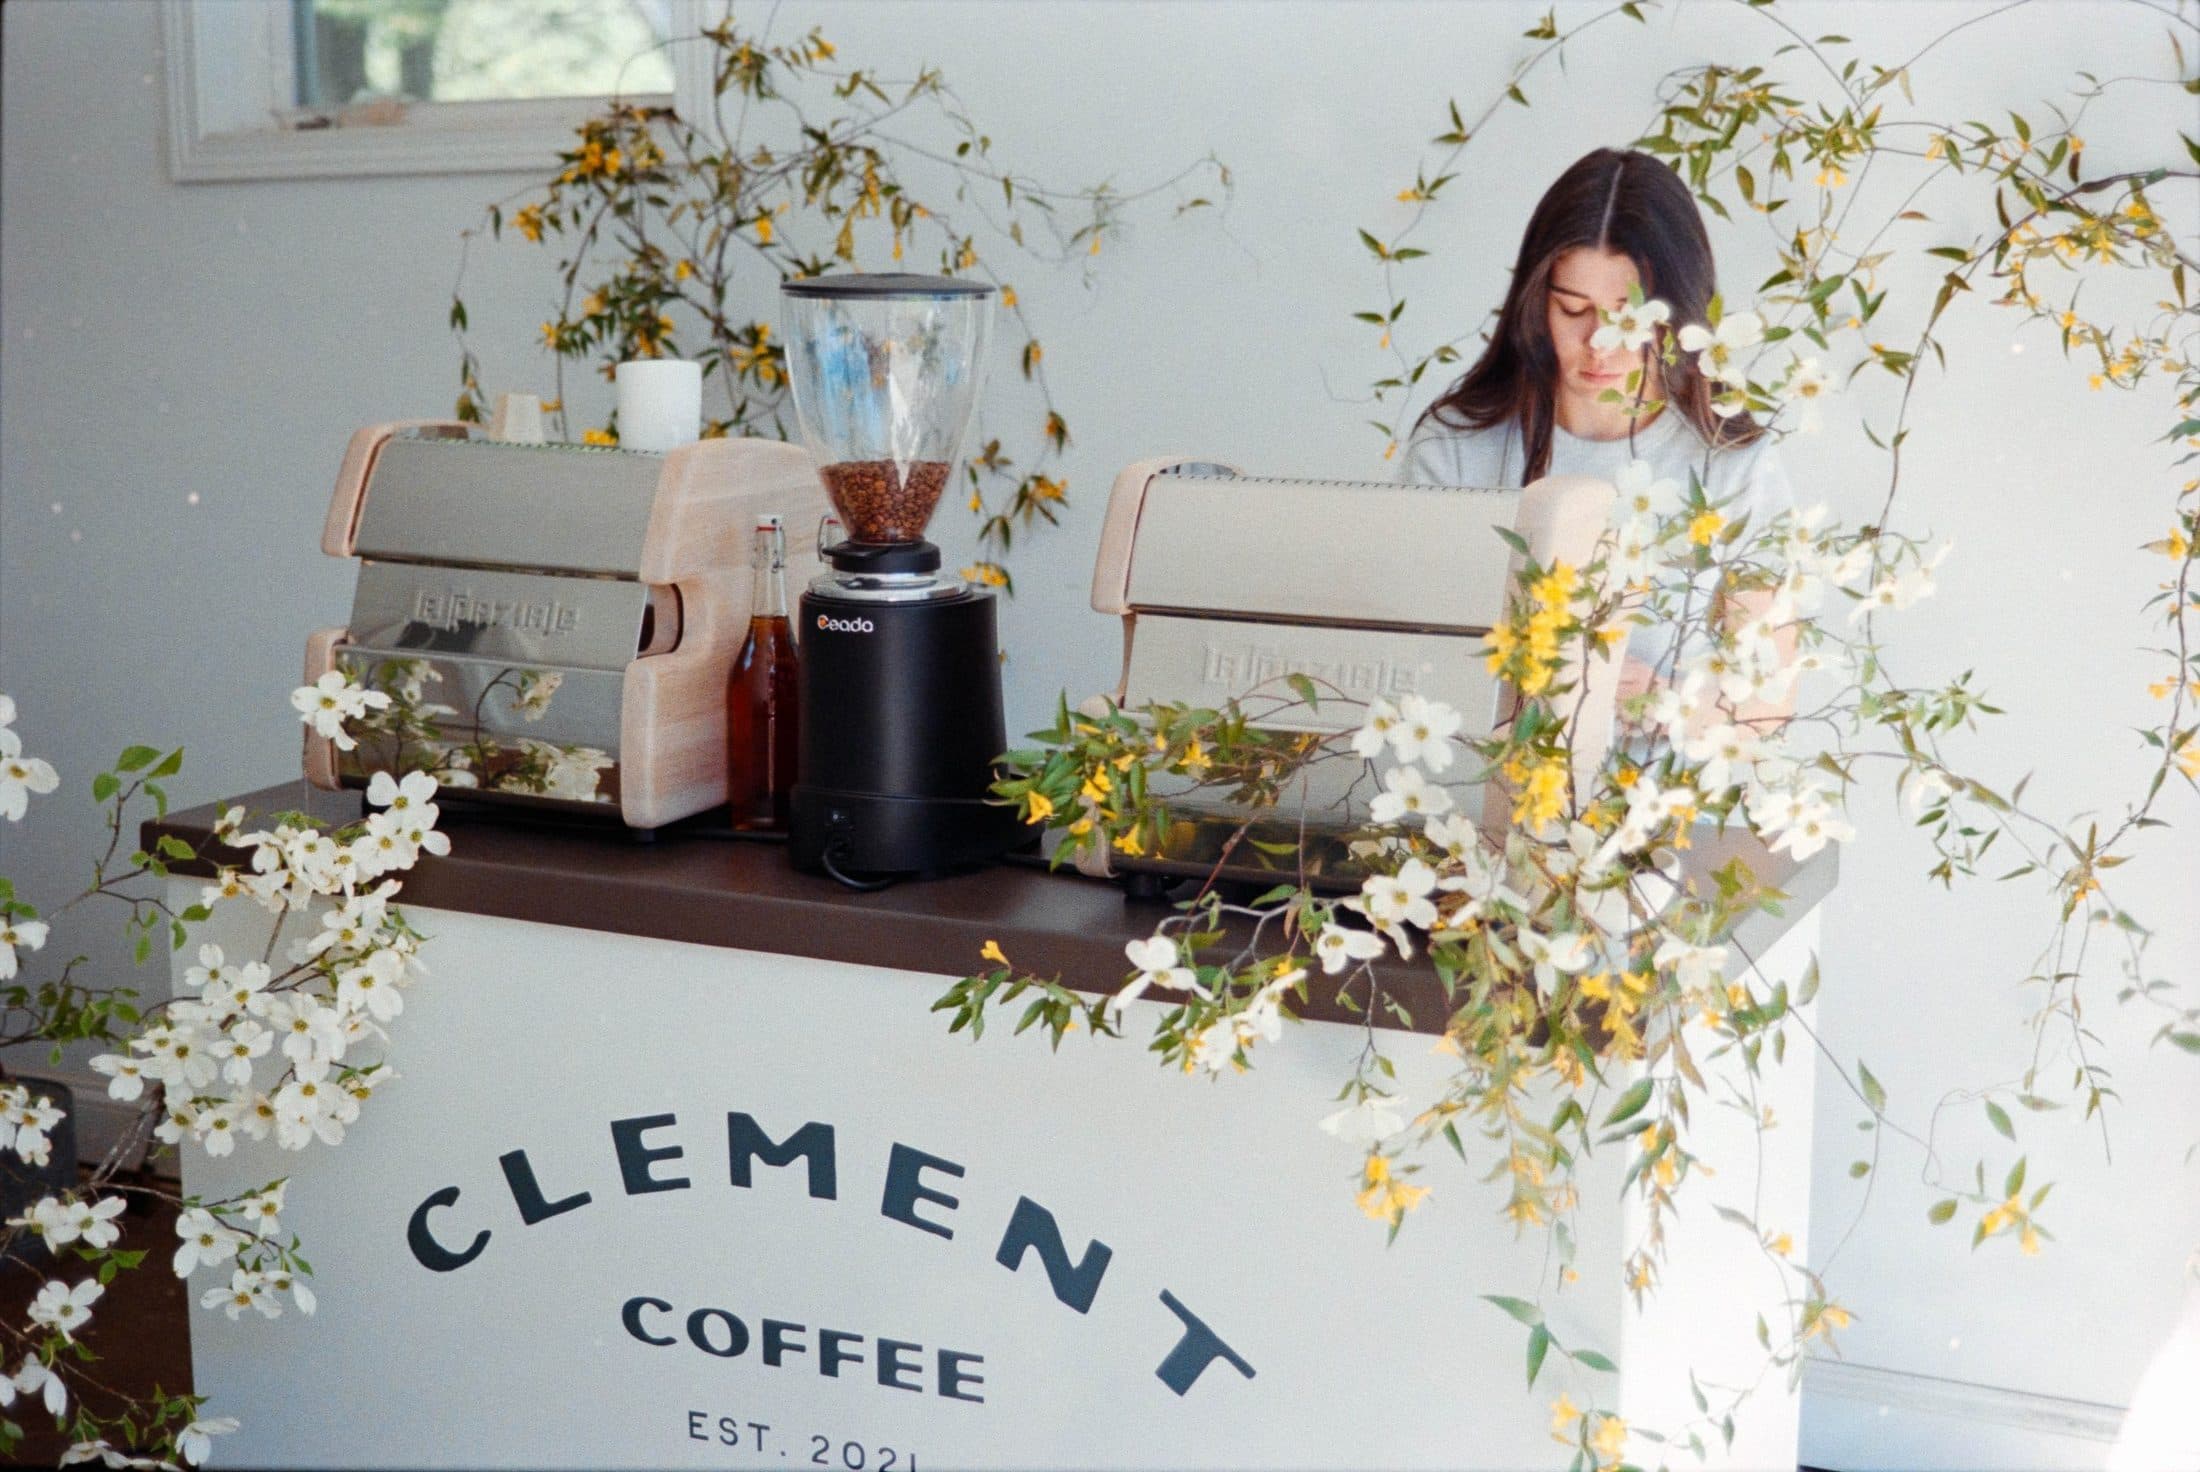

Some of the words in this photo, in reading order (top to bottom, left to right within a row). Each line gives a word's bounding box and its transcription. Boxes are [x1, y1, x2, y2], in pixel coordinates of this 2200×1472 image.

[817, 614, 874, 632] Ceado
[406, 1111, 1256, 1397] CLEMENT
[621, 1296, 985, 1403] COFFEE
[688, 1410, 786, 1457] EST.
[811, 1435, 916, 1472] 2021
